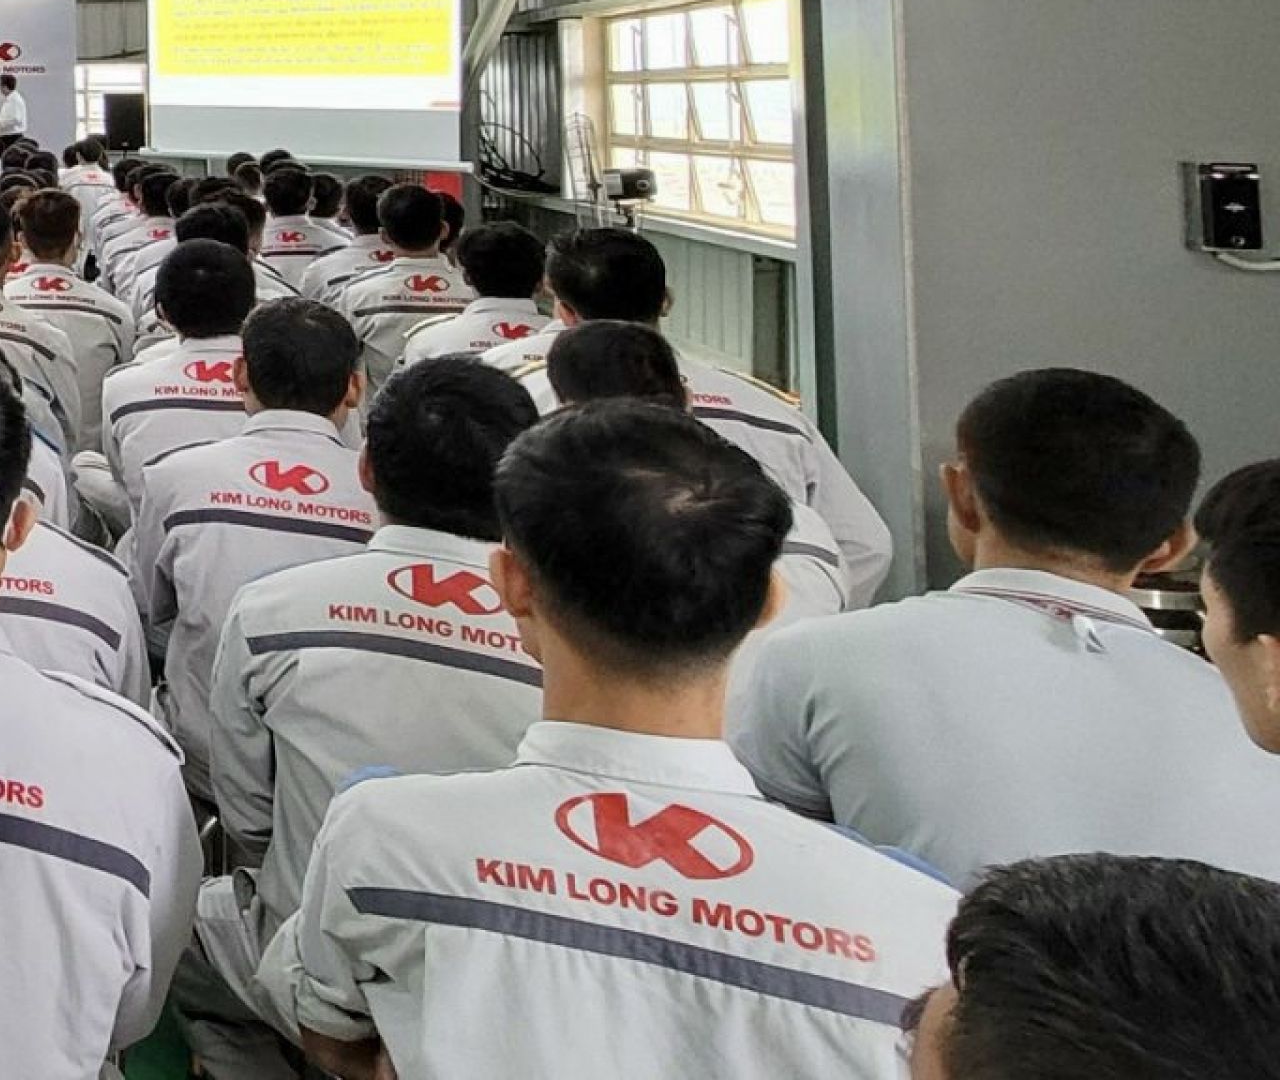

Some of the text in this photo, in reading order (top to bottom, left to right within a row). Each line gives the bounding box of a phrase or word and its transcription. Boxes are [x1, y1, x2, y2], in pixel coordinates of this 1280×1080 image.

[155, 385, 180, 395] KIM
[210, 491, 372, 524] KIM LONG MOTORS
[328, 604, 522, 652] KIM LONG MOT
[475, 857, 877, 963] KIM LONG MOTORS
